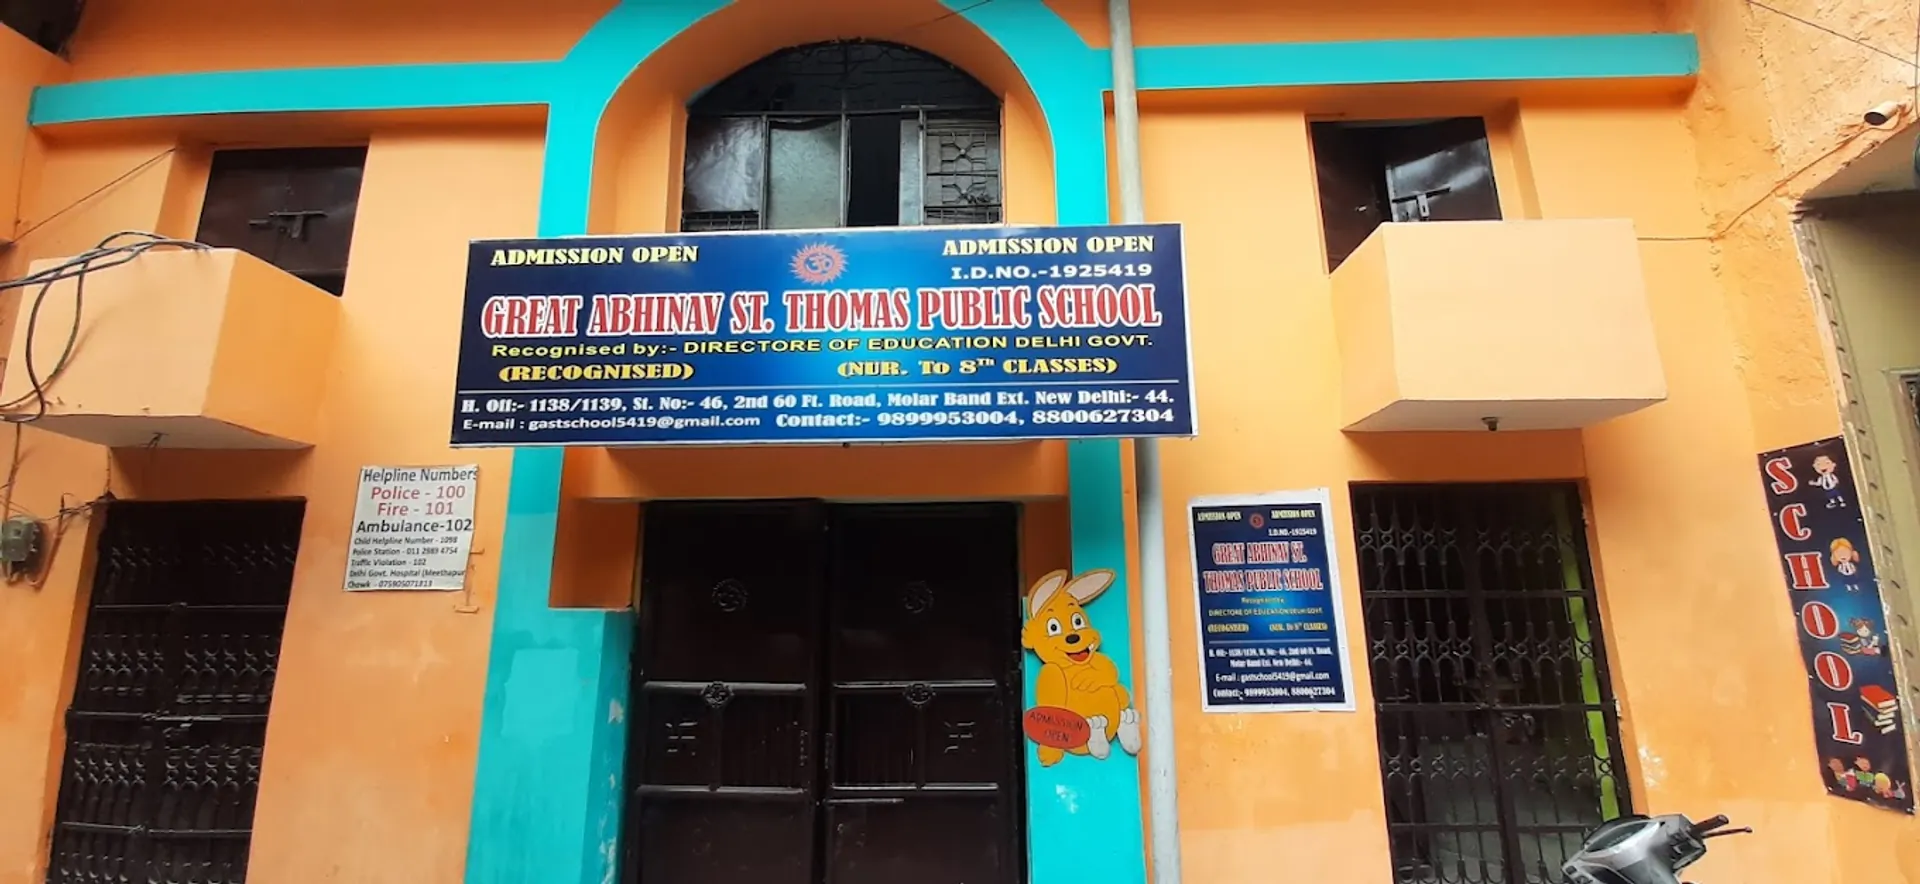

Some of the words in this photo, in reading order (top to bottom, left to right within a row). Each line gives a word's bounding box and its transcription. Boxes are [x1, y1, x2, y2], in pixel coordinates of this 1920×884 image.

[942, 237, 1077, 255] ADMISSION
[1086, 235, 1154, 253] OPEN
[490, 247, 624, 266] ADMISSION
[632, 246, 699, 263] OPEN
[951, 264, 1152, 280] I.D.NO.-1925419
[481, 295, 582, 337] GREAT
[587, 292, 726, 336] ABHINAV
[730, 291, 775, 333] ST.
[783, 289, 909, 332] THOMAS
[919, 286, 1033, 330] PUBLIC
[1037, 283, 1163, 328] SCHOOL
[492, 343, 625, 359] Recognised
[633, 343, 677, 357] by:-
[684, 339, 821, 354] DIRECTORE
[829, 338, 860, 351] OF
[868, 336, 1007, 350] EDUCATION
[1015, 335, 1080, 348] DELHI
[1087, 334, 1153, 347] GOVT.
[499, 363, 694, 382] (RECOGNISED)
[837, 360, 909, 377] (NUR.
[919, 360, 951, 375] To
[1002, 358, 1118, 374] CLASSES)
[461, 399, 480, 412] H.
[486, 398, 525, 412] Off:-
[529, 397, 627, 412] 1138/1139,
[632, 397, 653, 410] St.
[659, 396, 695, 410] No:-
[700, 396, 728, 410] 46,
[733, 395, 768, 409] 2nd
[773, 395, 796, 408] 60
[801, 394, 823, 407] Ft.
[829, 394, 882, 408] Road,
[887, 393, 939, 406] Molar
[943, 392, 991, 406] Band
[997, 391, 1029, 405] Ext.
[1035, 391, 1072, 405] New
[1077, 390, 1139, 404] Delhi:-
[1144, 389, 1174, 403] 44.
[463, 418, 515, 430] E-mail
[528, 415, 760, 431] gastschool5419@gmail.com
[776, 412, 870, 427] Contact:-
[877, 410, 1024, 426] 9899953004,
[1032, 408, 1174, 424] 8800627304
[363, 468, 416, 484] Helpline
[370, 486, 420, 499] Police
[436, 485, 466, 499] 100
[377, 503, 409, 516] Fire
[425, 502, 453, 515] 101
[355, 518, 473, 533] Ambulance-102
[372, 536, 402, 546] Helpline
[404, 536, 434, 544] Number
[374, 547, 400, 555] Station
[1212, 542, 1245, 565] GREAT
[1247, 541, 1289, 564] ABHINAV
[1290, 541, 1308, 562] ST.
[368, 569, 388, 577] Govt.
[390, 569, 420, 578] Hospital
[1203, 570, 1244, 593] THOMAS
[1246, 569, 1283, 591] PUBLIC
[1283, 568, 1323, 590] SCHOOL
[347, 580, 370, 588] Chowk
[1765, 456, 1863, 745] SCHOOL
[1215, 673, 1237, 682] E-mail
[1030, 712, 1083, 731] ADMISSION
[1044, 729, 1069, 742] OPEN
